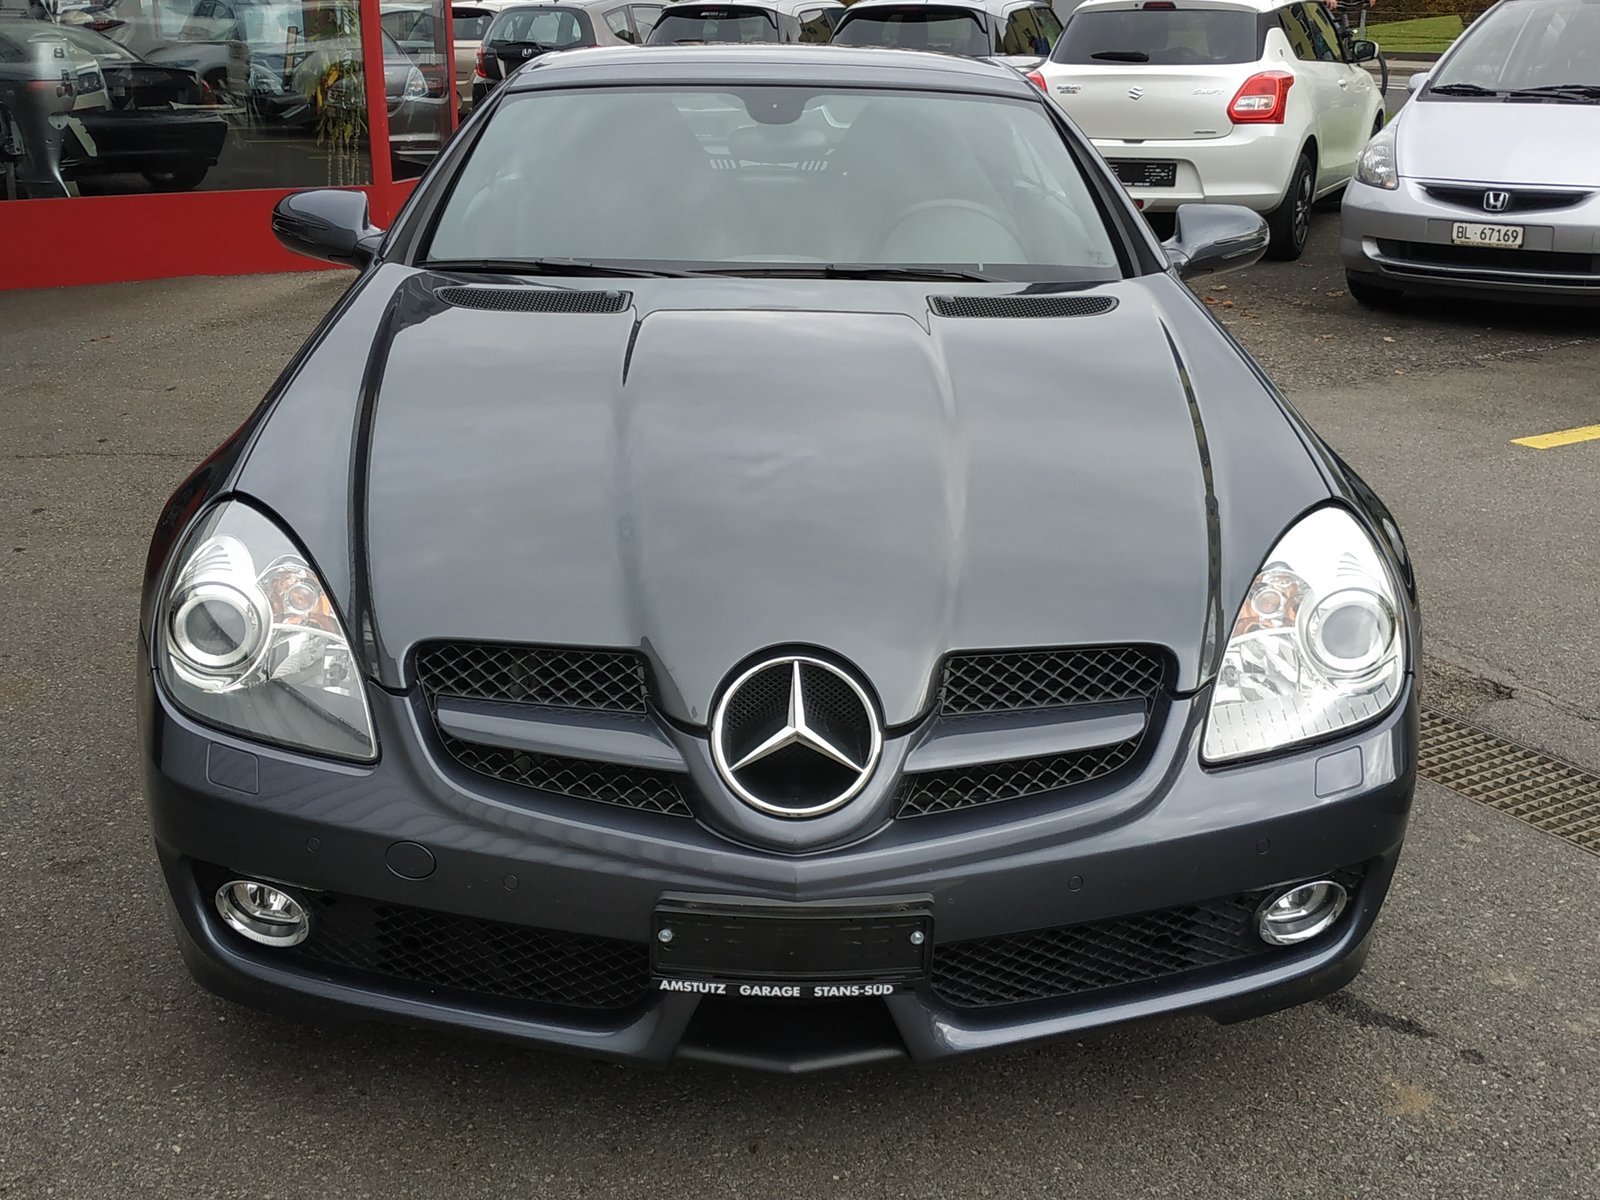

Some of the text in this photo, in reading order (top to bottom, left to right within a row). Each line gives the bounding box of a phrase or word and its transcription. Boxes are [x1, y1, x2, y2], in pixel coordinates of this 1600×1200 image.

[1456, 226, 1519, 243] BL 67169
[659, 980, 894, 997] AMSTUTZ GARAGE STANS-SÜD
